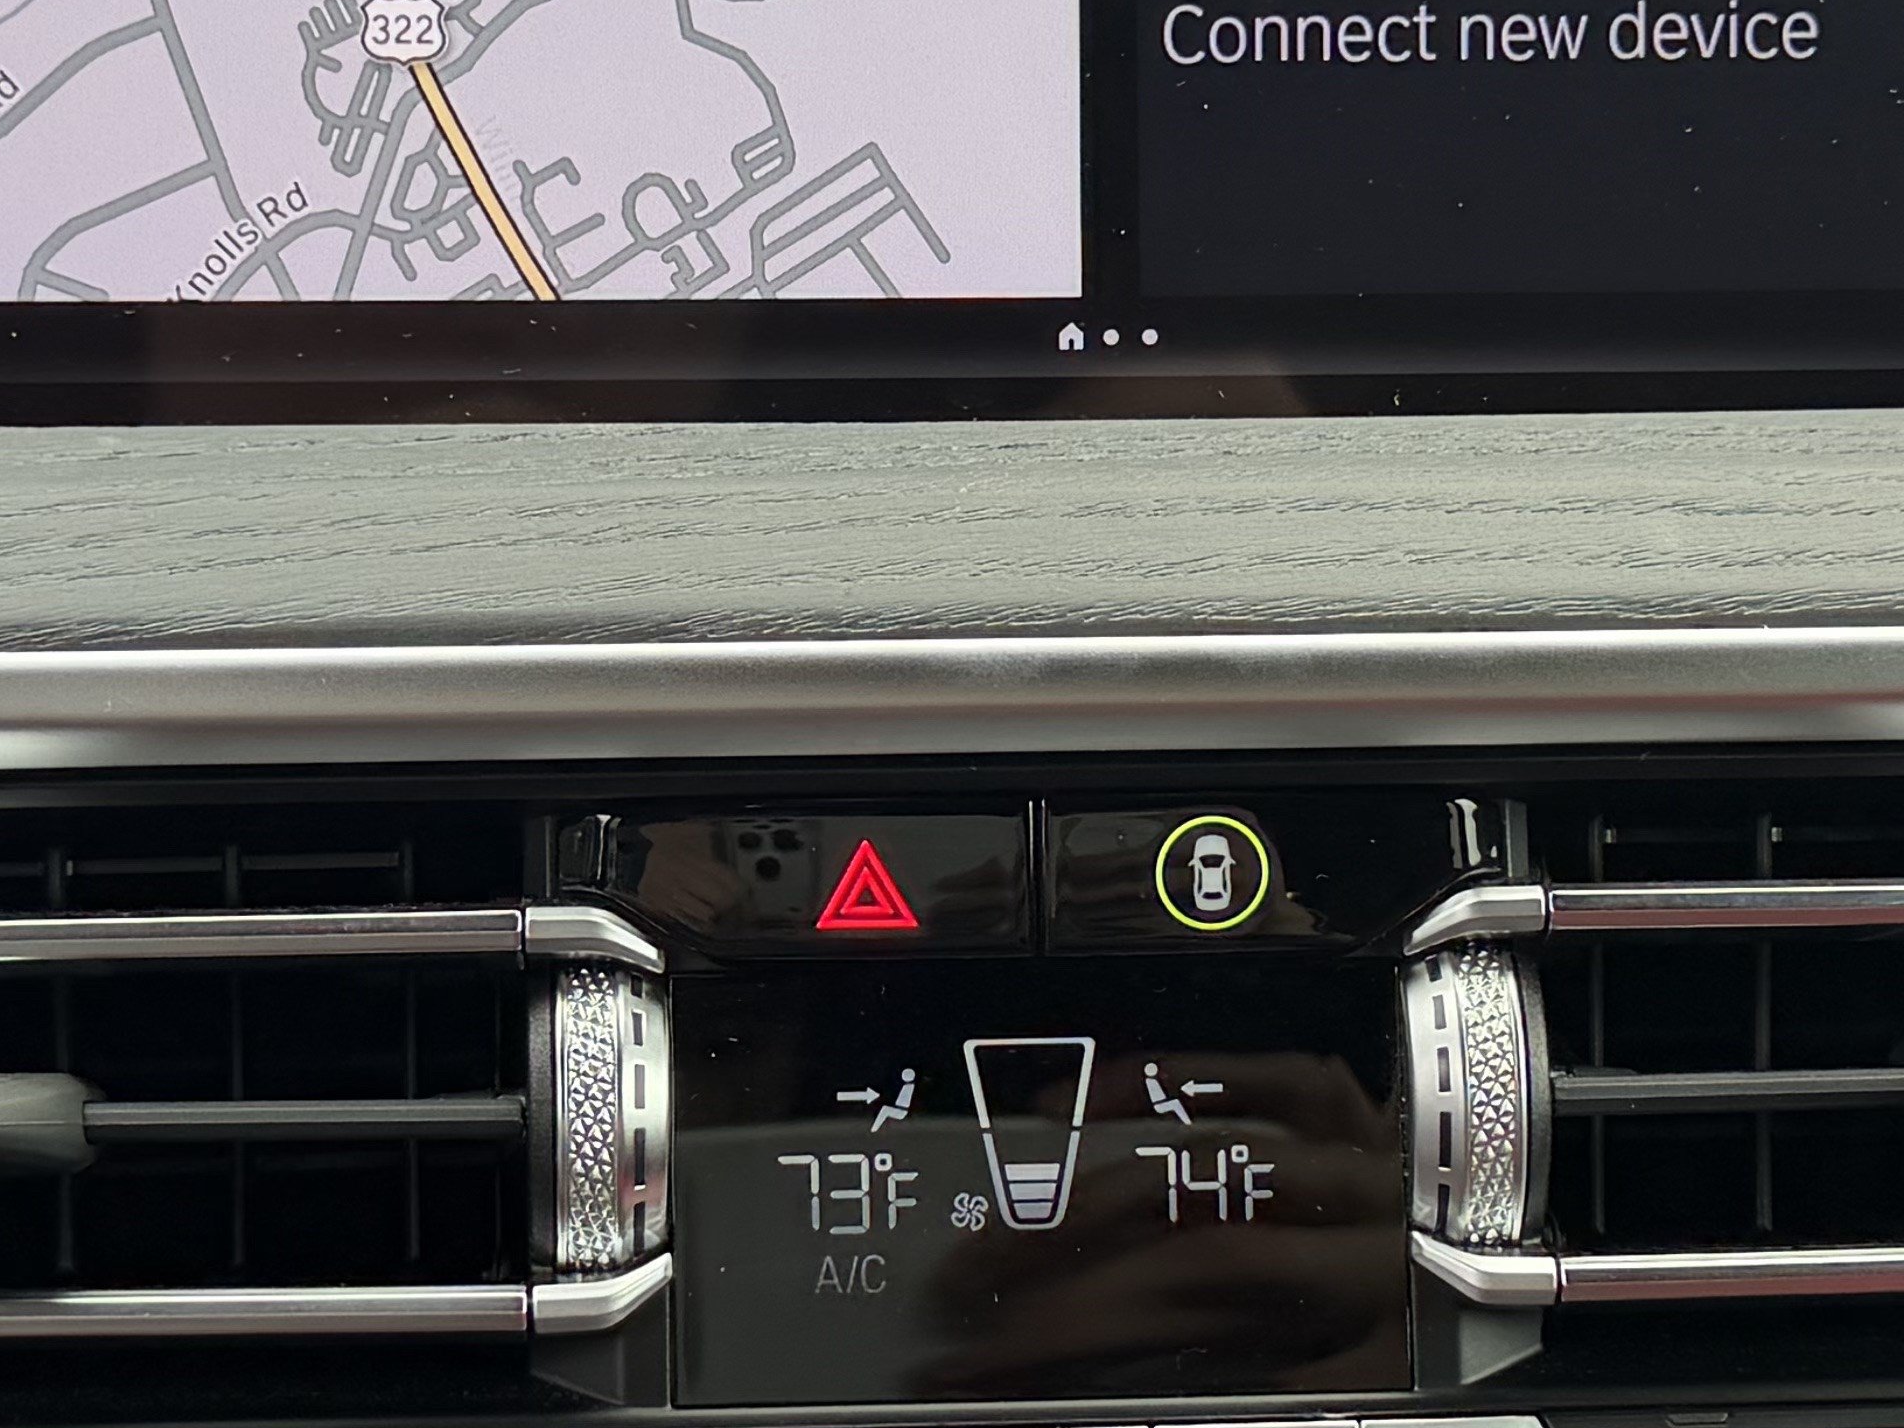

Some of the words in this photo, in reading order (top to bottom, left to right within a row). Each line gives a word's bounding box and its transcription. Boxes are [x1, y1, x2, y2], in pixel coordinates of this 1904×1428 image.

[371, 13, 436, 48] 322
[1160, 2, 1438, 66] Connect
[1458, 12, 1589, 62] new
[256, 181, 309, 228] Rd
[778, 1152, 919, 1234] 73°F
[1134, 1144, 1276, 1223] 74°F
[814, 1256, 888, 1296] A/C
